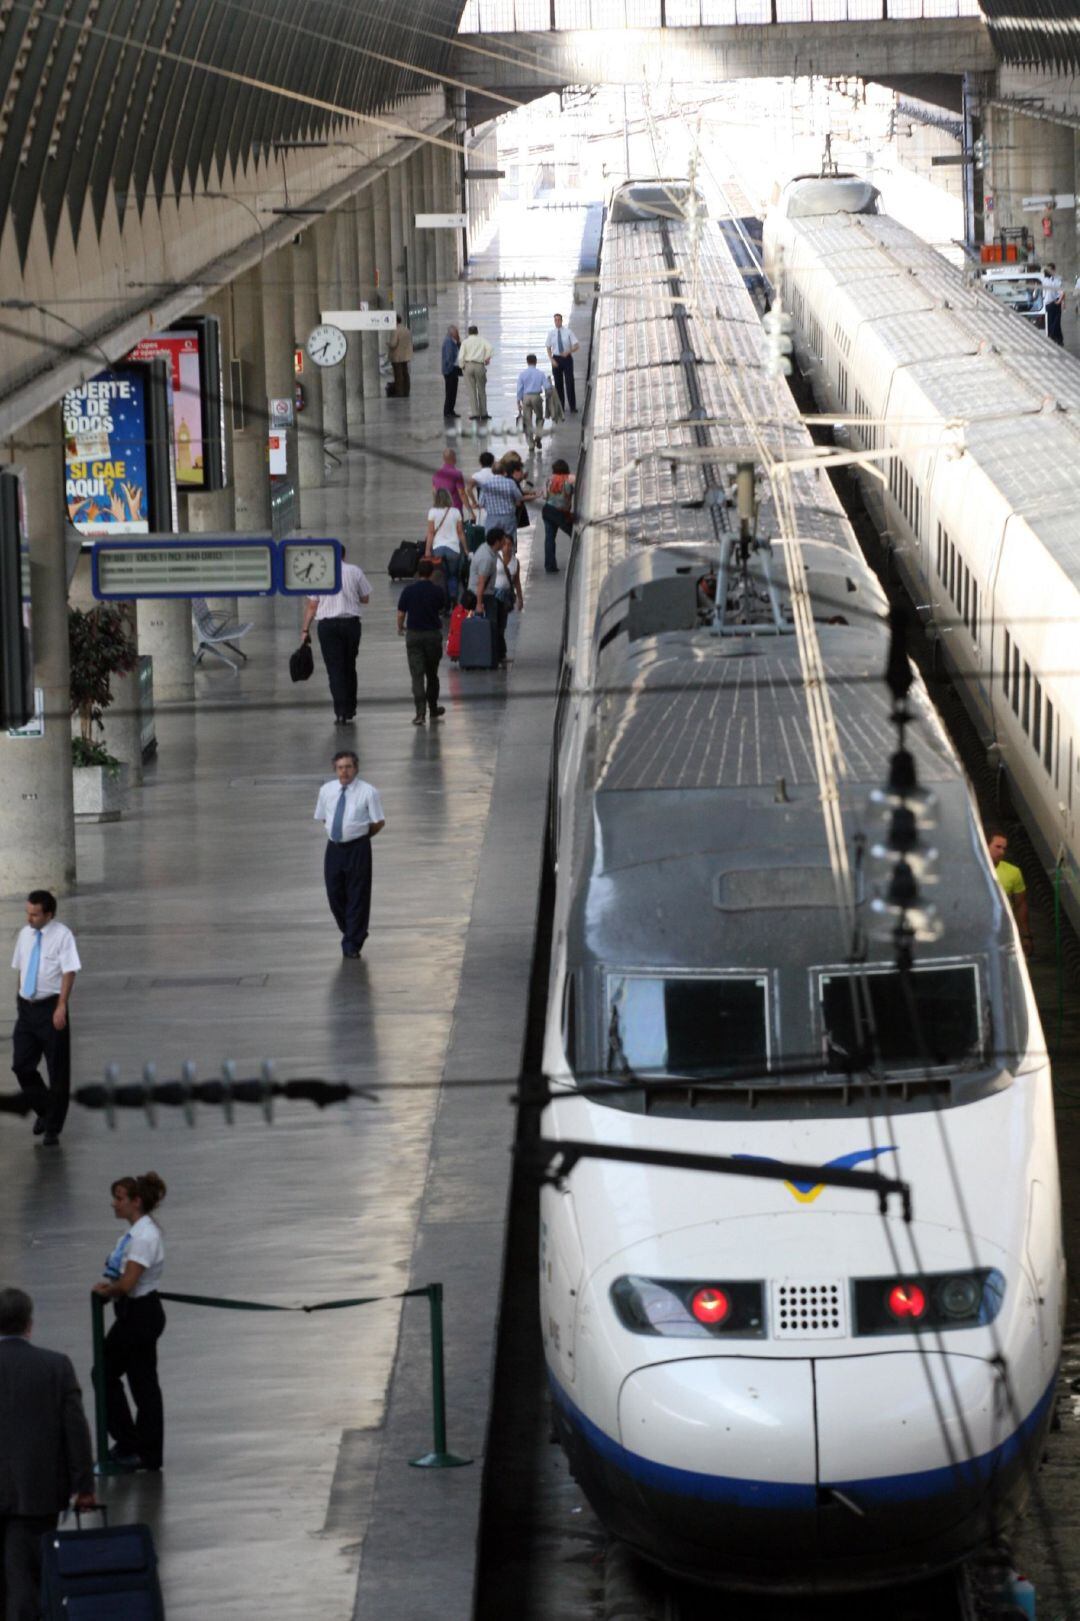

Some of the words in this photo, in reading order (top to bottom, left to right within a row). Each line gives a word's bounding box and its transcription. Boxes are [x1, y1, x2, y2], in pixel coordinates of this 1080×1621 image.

[384, 316, 390, 324] 4
[86, 399, 110, 416] DE
[70, 461, 88, 478] SI
[92, 461, 126, 478] CAE
